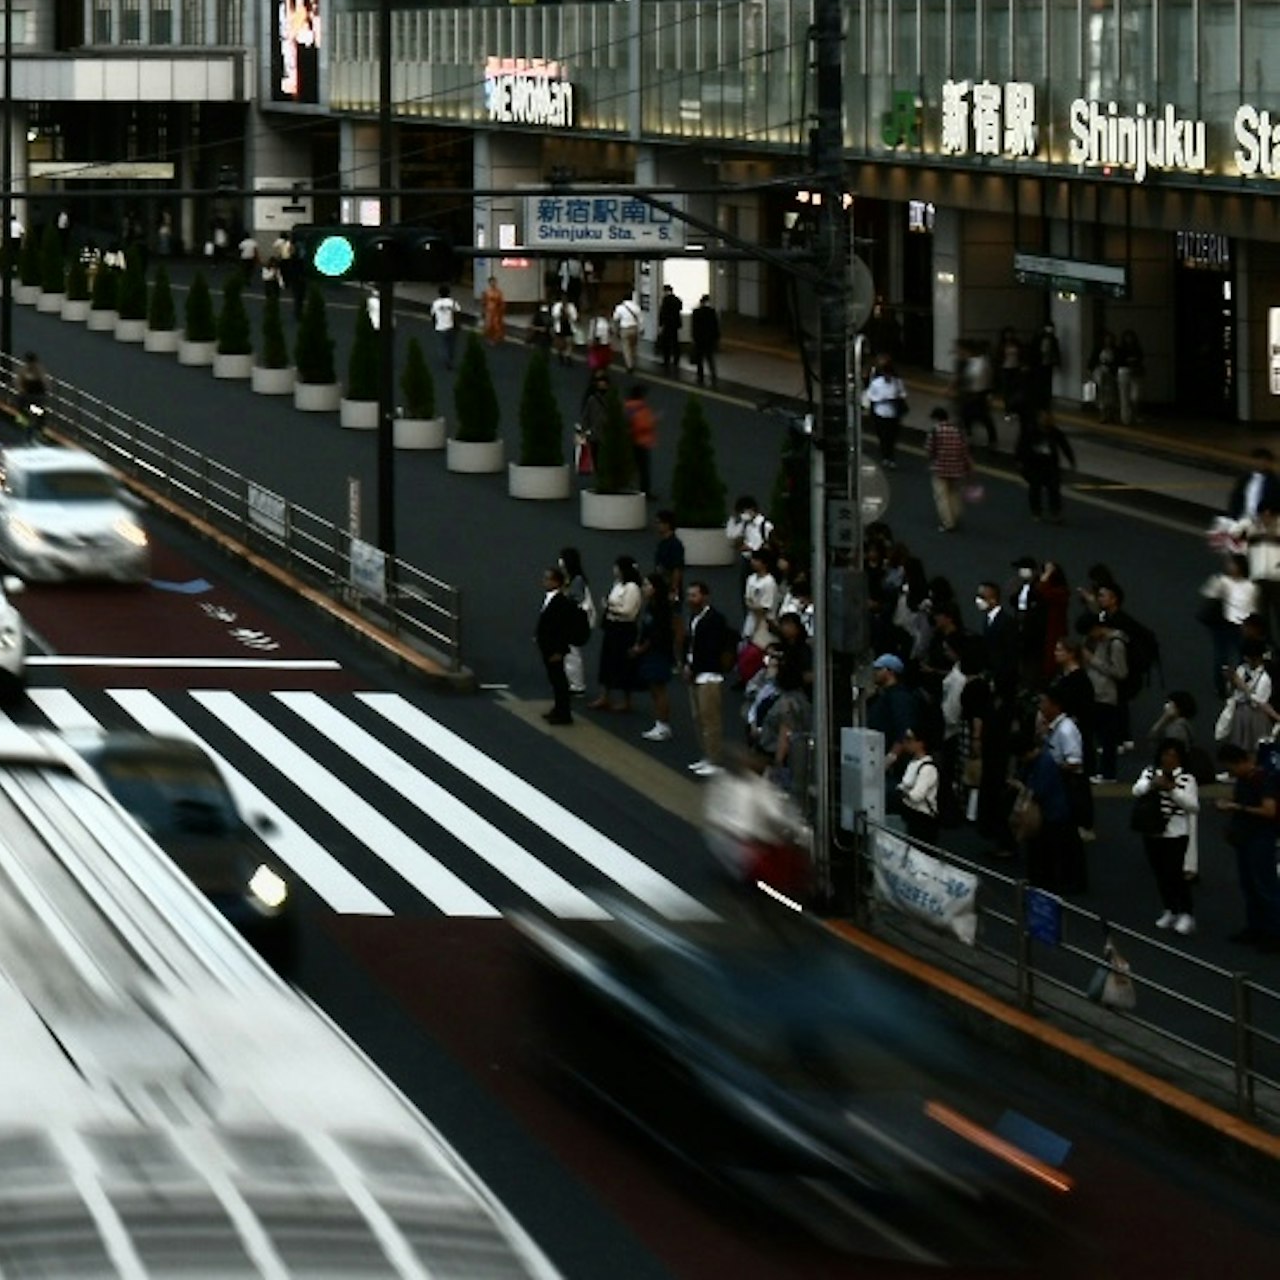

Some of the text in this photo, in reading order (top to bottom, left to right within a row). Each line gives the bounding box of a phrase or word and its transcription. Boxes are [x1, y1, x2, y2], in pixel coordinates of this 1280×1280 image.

[489, 76, 573, 127] NEWoMan
[940, 78, 1037, 156] 新宿駅
[1068, 98, 1207, 183] Shinjuku
[537, 198, 674, 224] 新宿駅南口
[539, 224, 602, 242] Shinjuku
[608, 224, 636, 240] Sta.
[657, 224, 672, 240] S.
